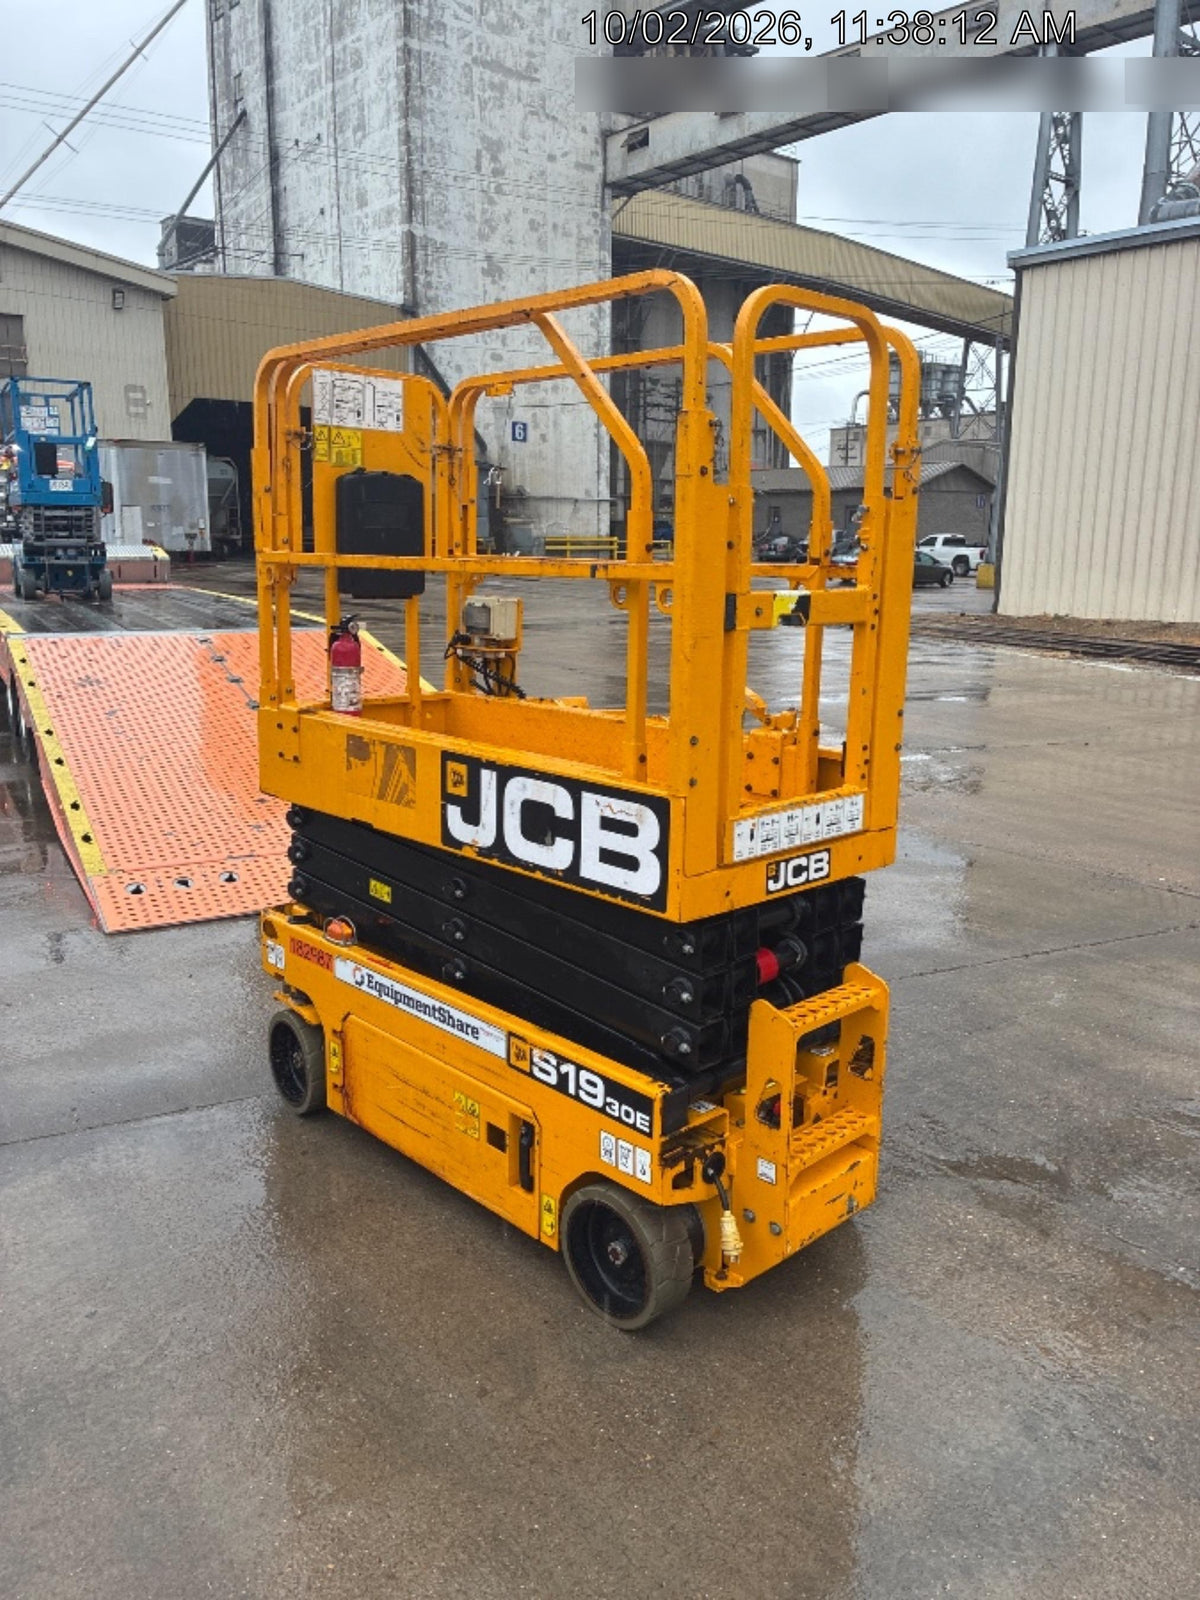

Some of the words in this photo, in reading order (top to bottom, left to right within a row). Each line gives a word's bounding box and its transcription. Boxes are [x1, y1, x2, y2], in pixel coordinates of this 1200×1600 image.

[515, 424, 525, 440] 6
[446, 768, 662, 896] JCB
[767, 851, 830, 892] JCB
[366, 972, 480, 1041] EquipmentShare
